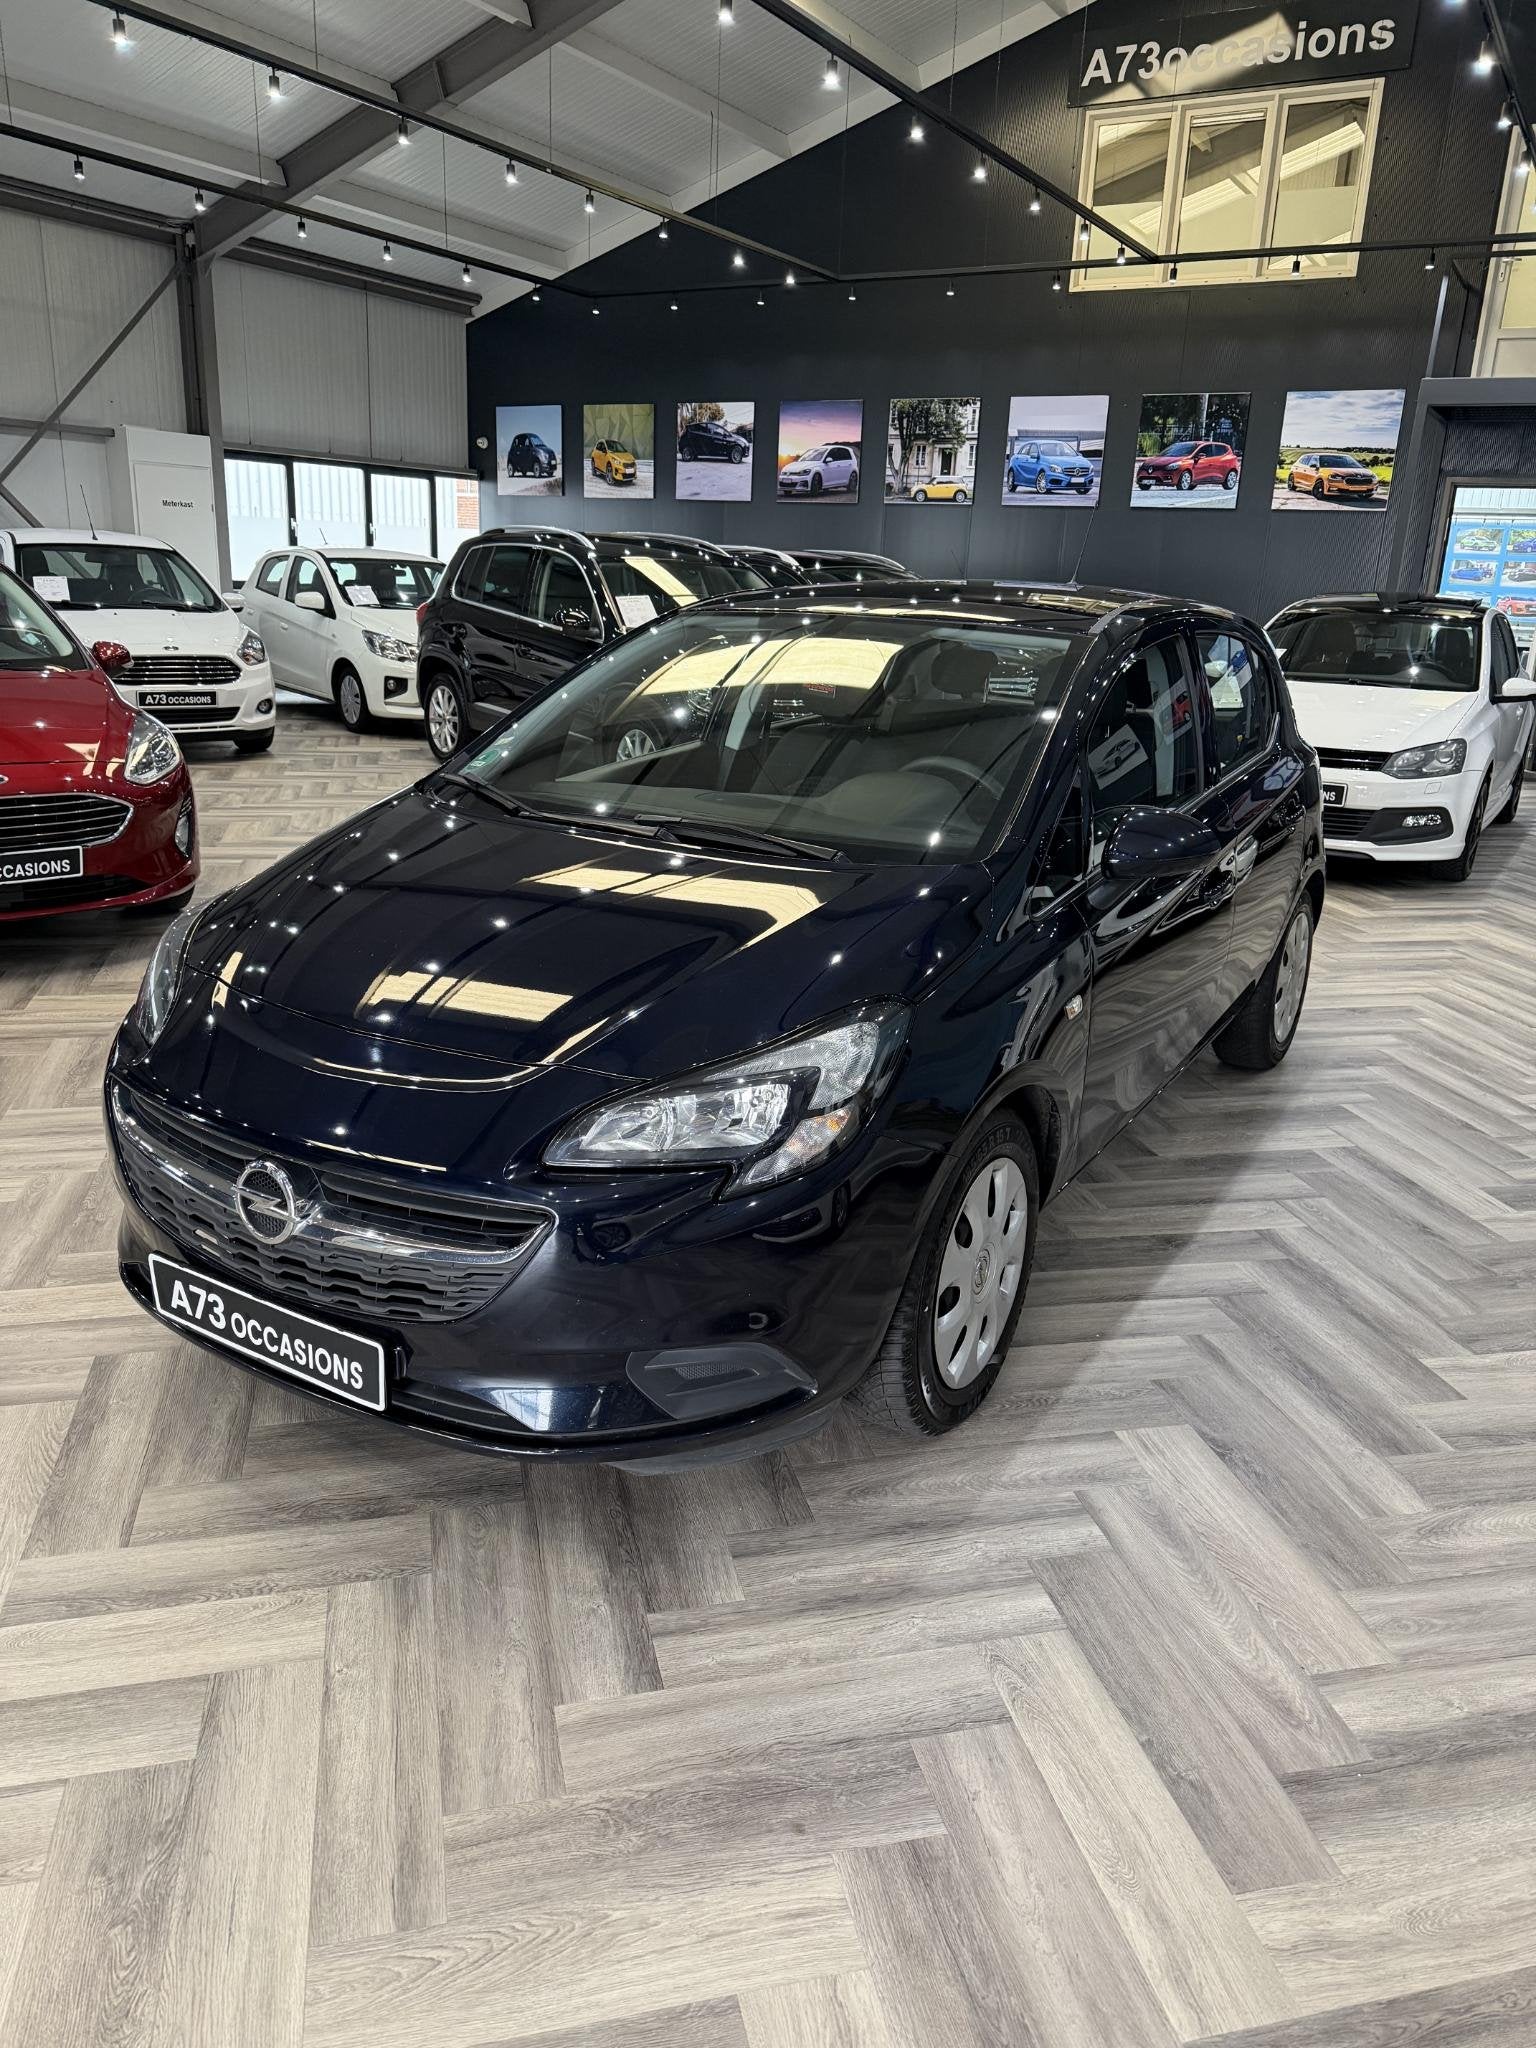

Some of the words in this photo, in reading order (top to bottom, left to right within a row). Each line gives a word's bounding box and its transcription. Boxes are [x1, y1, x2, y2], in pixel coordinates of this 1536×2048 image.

[1081, 18, 1396, 87] A73occasions
[162, 499, 194, 508] Meterkast
[145, 694, 167, 704] A73
[168, 696, 212, 704] OCCASIONS
[0, 859, 71, 878] CASIONS
[171, 1279, 226, 1330] A73
[231, 1312, 363, 1389] OCCASIONS
